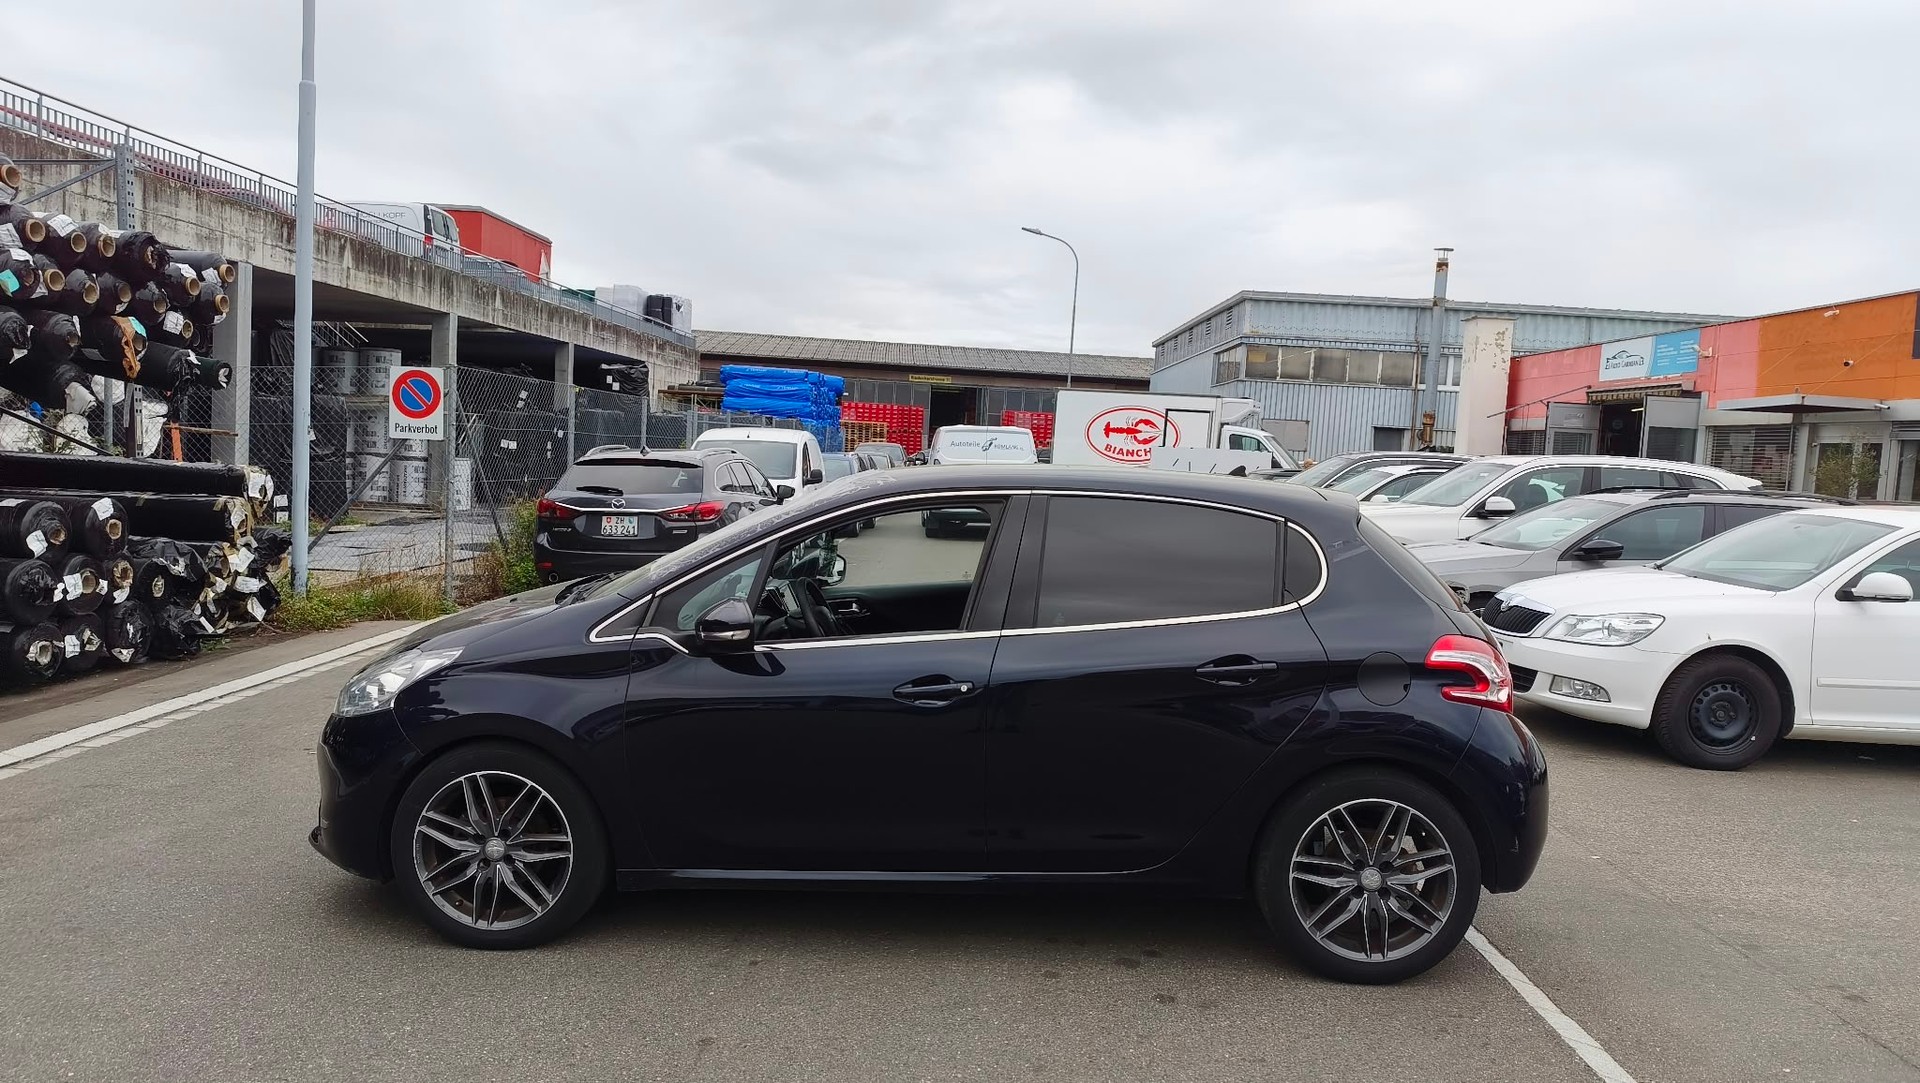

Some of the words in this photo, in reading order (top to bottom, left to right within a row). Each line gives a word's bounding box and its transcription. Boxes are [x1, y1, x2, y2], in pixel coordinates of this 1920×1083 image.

[394, 422, 438, 434] Parkverbot
[950, 440, 981, 448] Autoteile
[1104, 443, 1152, 458] BIANCH
[615, 516, 625, 525] ZH
[602, 525, 618, 535] 633
[620, 525, 636, 535] 241
